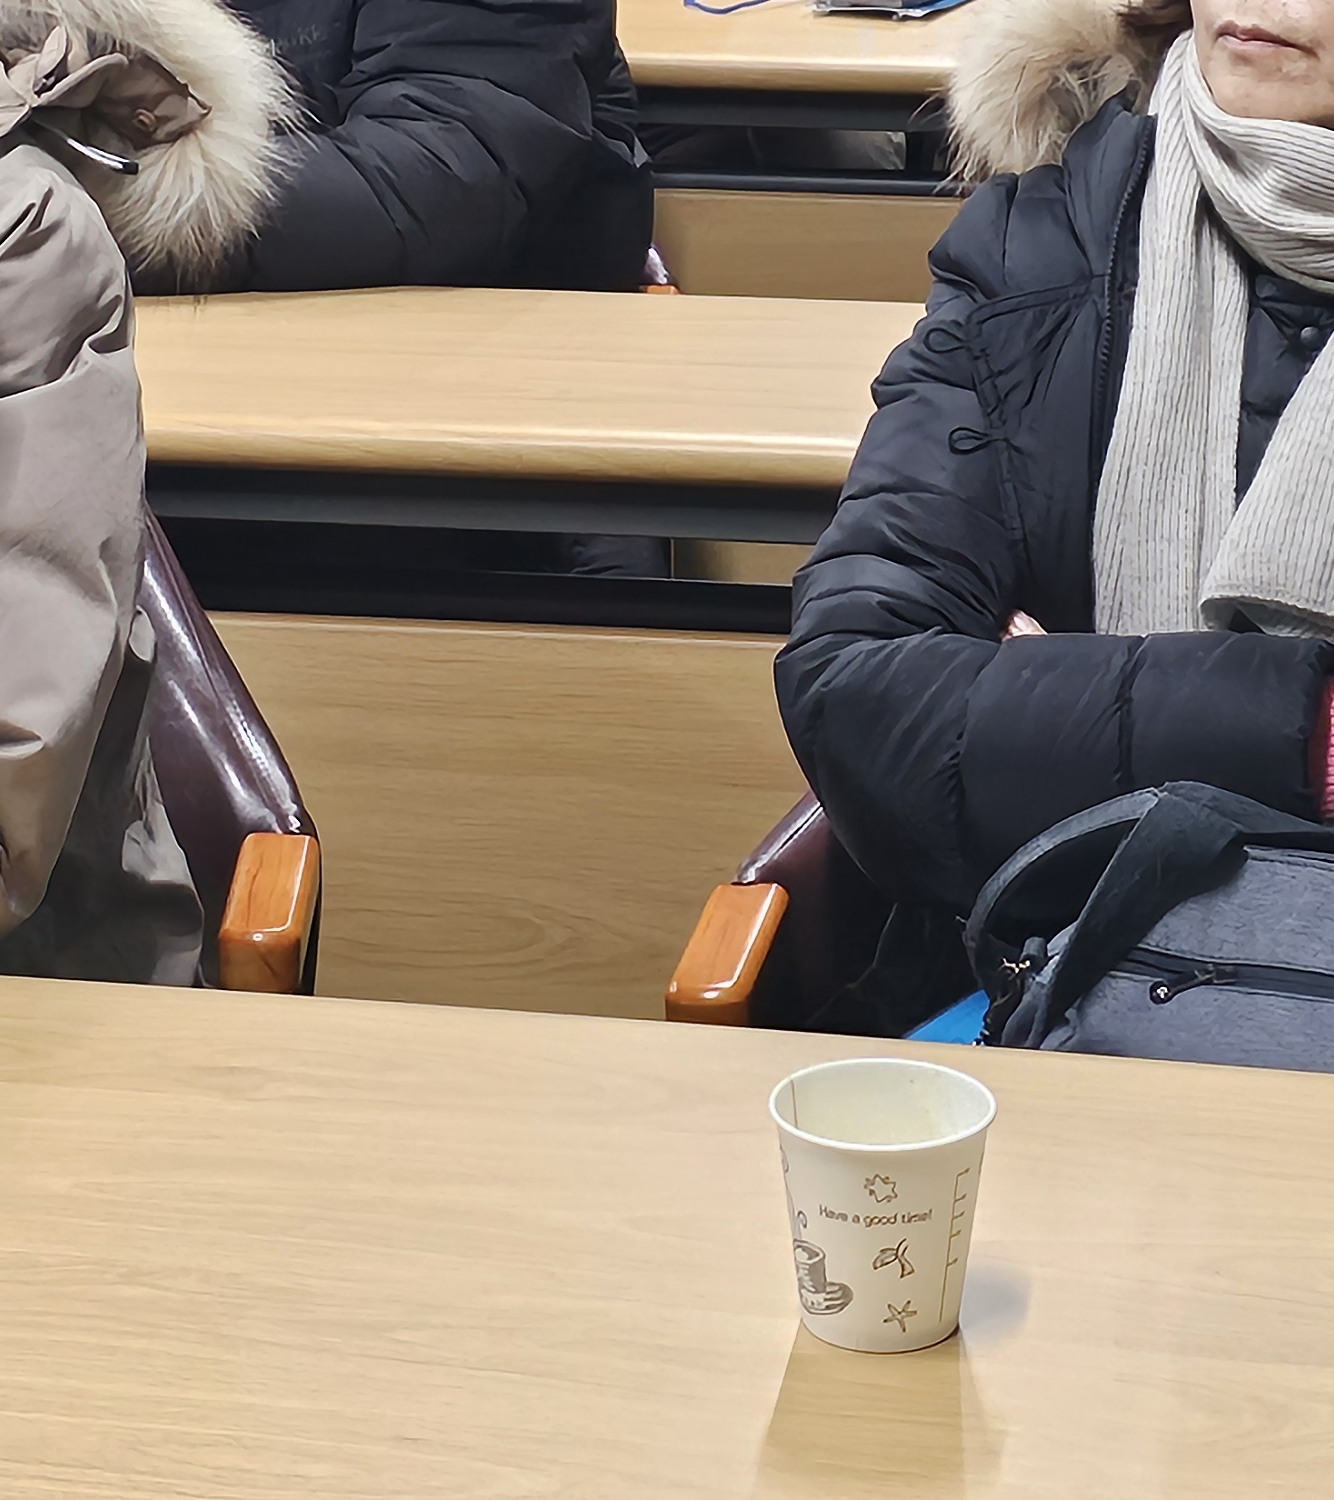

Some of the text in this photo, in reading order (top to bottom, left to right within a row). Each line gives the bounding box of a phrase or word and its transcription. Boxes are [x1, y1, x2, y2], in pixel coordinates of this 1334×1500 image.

[818, 1203, 848, 1222] Have
[852, 1214, 861, 1224] a
[863, 1212, 898, 1228] good
